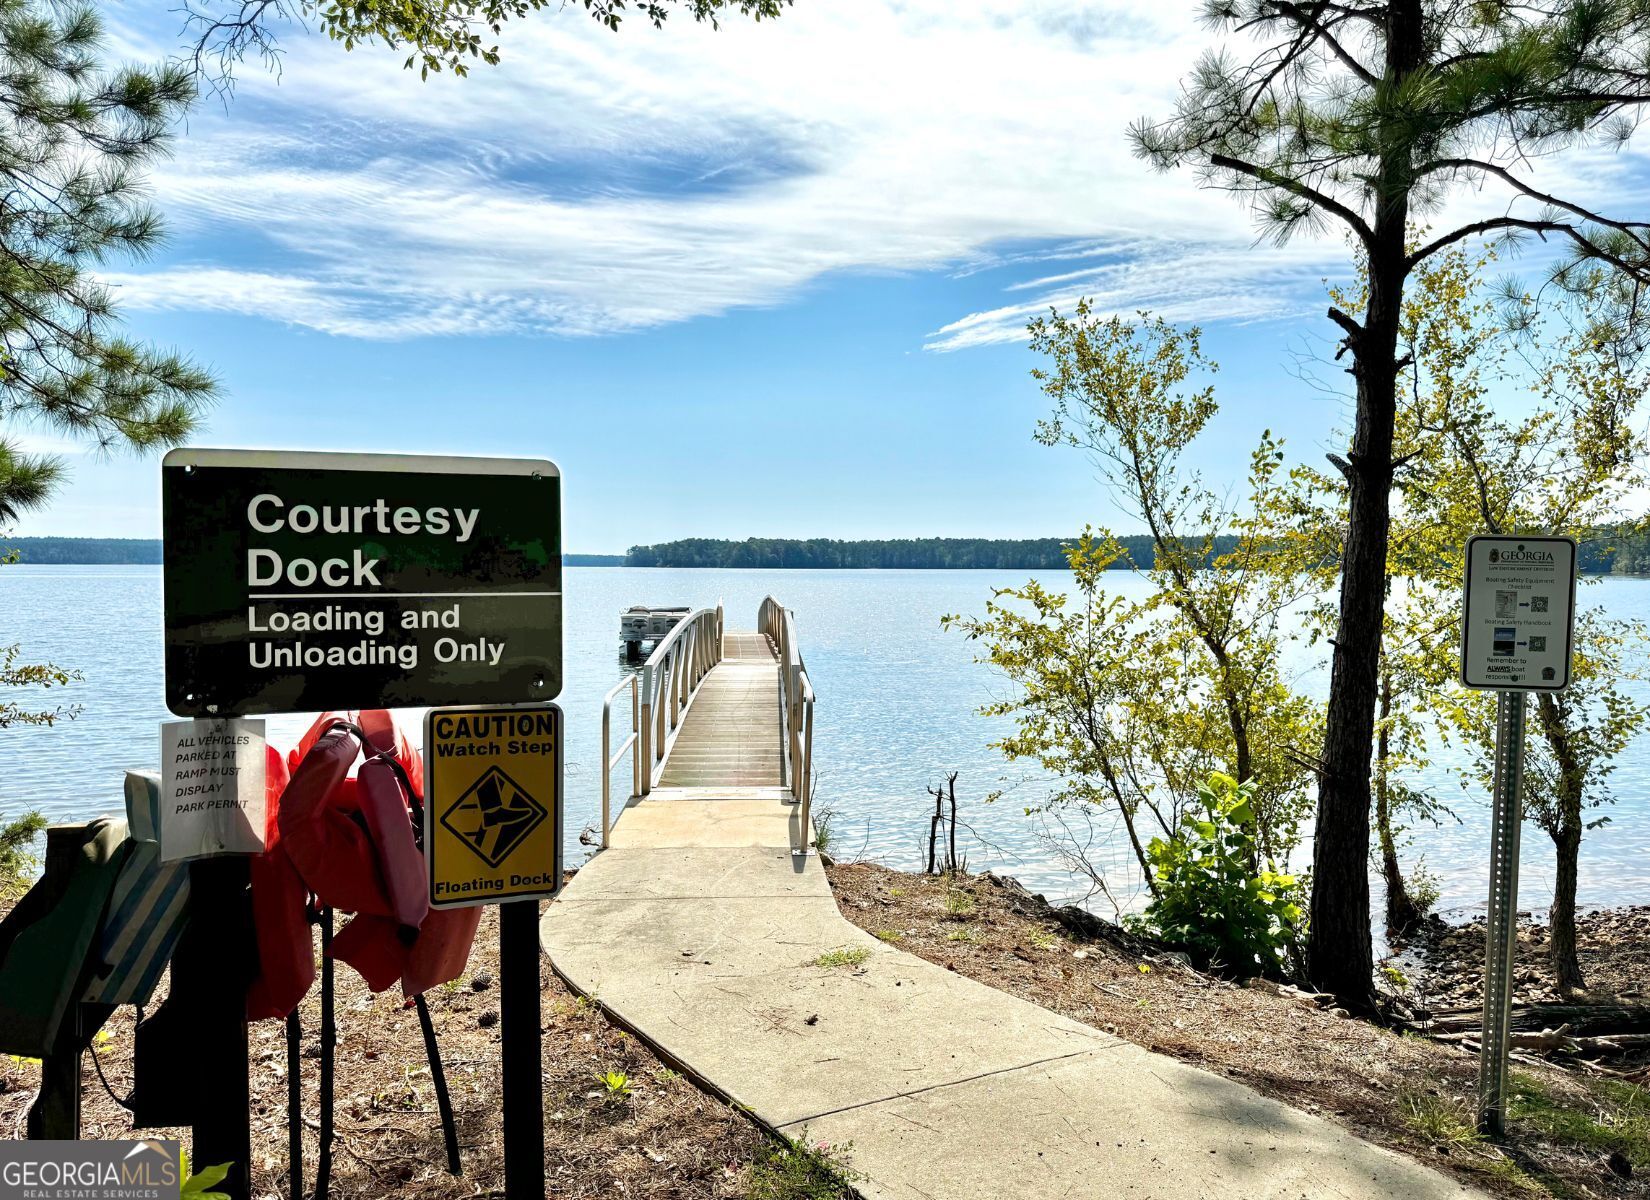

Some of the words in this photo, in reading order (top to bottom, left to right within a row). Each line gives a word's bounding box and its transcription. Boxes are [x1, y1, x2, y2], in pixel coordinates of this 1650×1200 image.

[247, 493, 480, 542] Courtesy
[1501, 551, 1555, 561] GEORGIA
[248, 548, 382, 587] Dock
[248, 605, 384, 635] Loading
[401, 604, 460, 629] and
[249, 640, 418, 669] Unloading
[433, 637, 505, 665] Only
[1486, 665, 1511, 673] ALWAYS
[1511, 665, 1525, 673] boat
[436, 714, 553, 740] CAUTION
[177, 738, 196, 748] ALL
[198, 736, 250, 746] VEHICLES
[436, 742, 501, 757] Watch
[507, 740, 553, 756] Step
[175, 751, 220, 763] PARKED
[223, 751, 237, 760] AT
[175, 768, 208, 780] RAMP
[209, 767, 242, 776] MUST
[175, 783, 224, 797] DISPLAY
[175, 802, 206, 814] PARK
[207, 800, 249, 809] PERMIT
[435, 877, 504, 895] Floating
[510, 872, 553, 887] Dock
